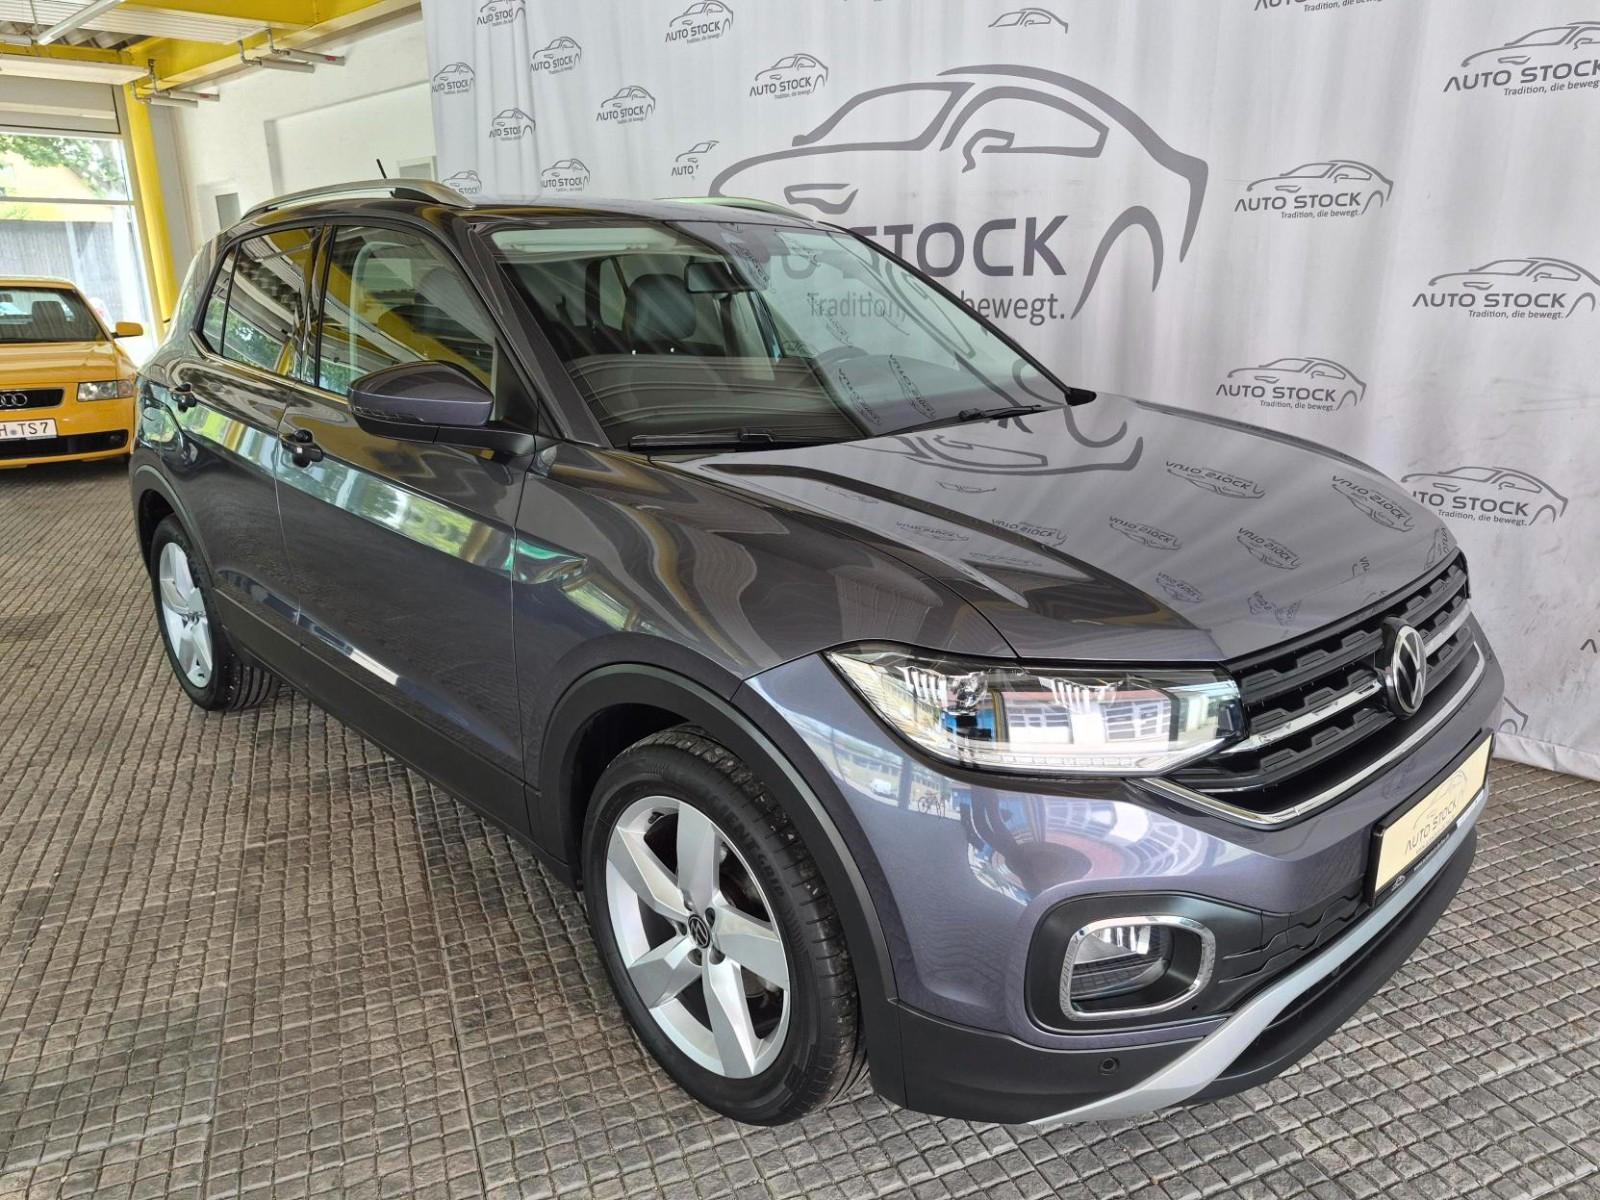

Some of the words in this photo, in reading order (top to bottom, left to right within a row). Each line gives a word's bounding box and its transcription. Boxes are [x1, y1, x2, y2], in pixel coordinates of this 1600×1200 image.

[665, 28, 689, 43] AUTO
[690, 20, 721, 37] STOCK
[530, 61, 551, 72] AUTO
[749, 83, 777, 97] AUTO
[779, 76, 812, 92] STOCK
[1443, 69, 1512, 93] AUTO
[1504, 85, 1548, 96] Tradition,
[1550, 82, 1566, 92] die
[1567, 79, 1600, 90] beweg
[596, 110, 619, 121] AUTO
[620, 105, 644, 119] STOCK
[671, 165, 694, 177] AUTO
[1234, 196, 1287, 212] AUTO
[1294, 192, 1362, 210] STOCK
[1281, 211, 1316, 219] Tradition,
[1317, 209, 1329, 218] die
[1412, 293, 1476, 308] AUTO
[1483, 293, 1568, 308] STOCK
[1469, 309, 1509, 319] Tradition,
[1511, 310, 1526, 319] die
[1528, 310, 1564, 320] bewegt.
[1216, 384, 1266, 398] AUTO
[1272, 386, 1337, 402] STOCK
[1260, 400, 1293, 409] Tradition,
[1413, 490, 1445, 507] TO
[1452, 496, 1529, 517] STOCK
[1438, 509, 1476, 520] Tradition,
[1478, 514, 1492, 522] die
